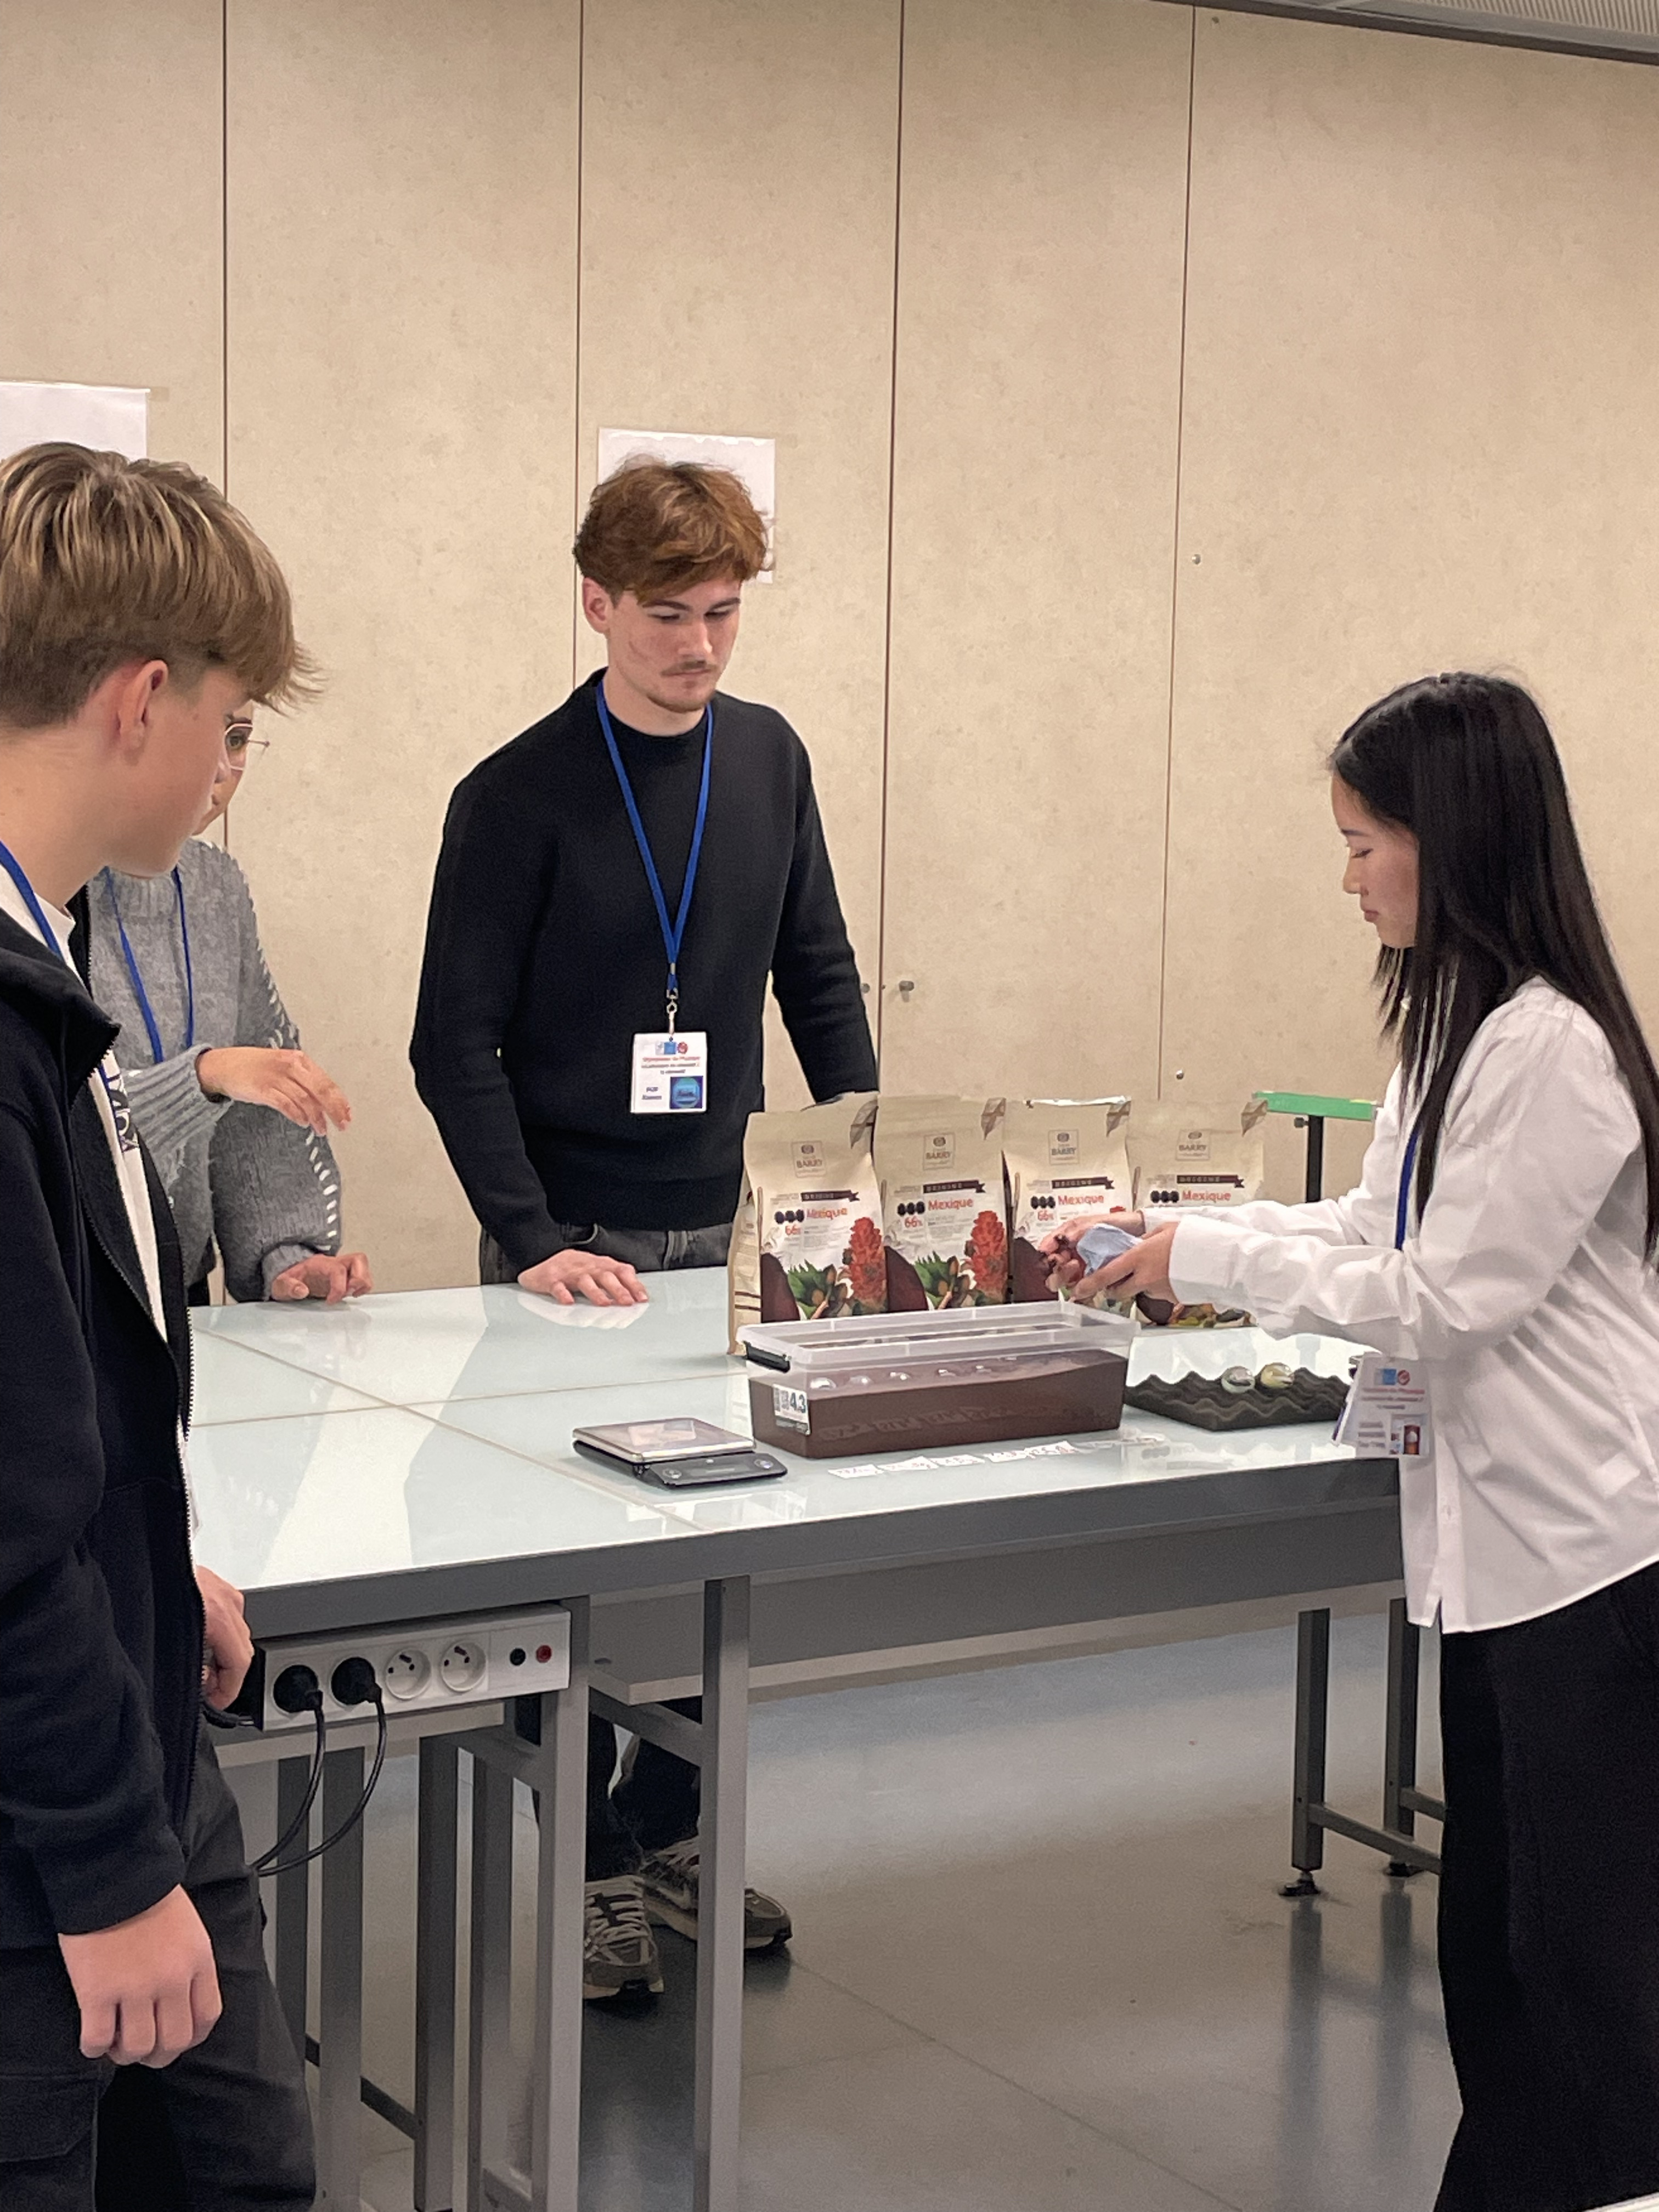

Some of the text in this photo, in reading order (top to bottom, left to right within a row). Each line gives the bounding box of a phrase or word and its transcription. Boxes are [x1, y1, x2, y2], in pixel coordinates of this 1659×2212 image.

[1058, 1195, 1104, 1206] Mexique
[1181, 1190, 1231, 1203] Mexique
[928, 1199, 973, 1210] Mexique
[806, 1208, 848, 1220] Mexique
